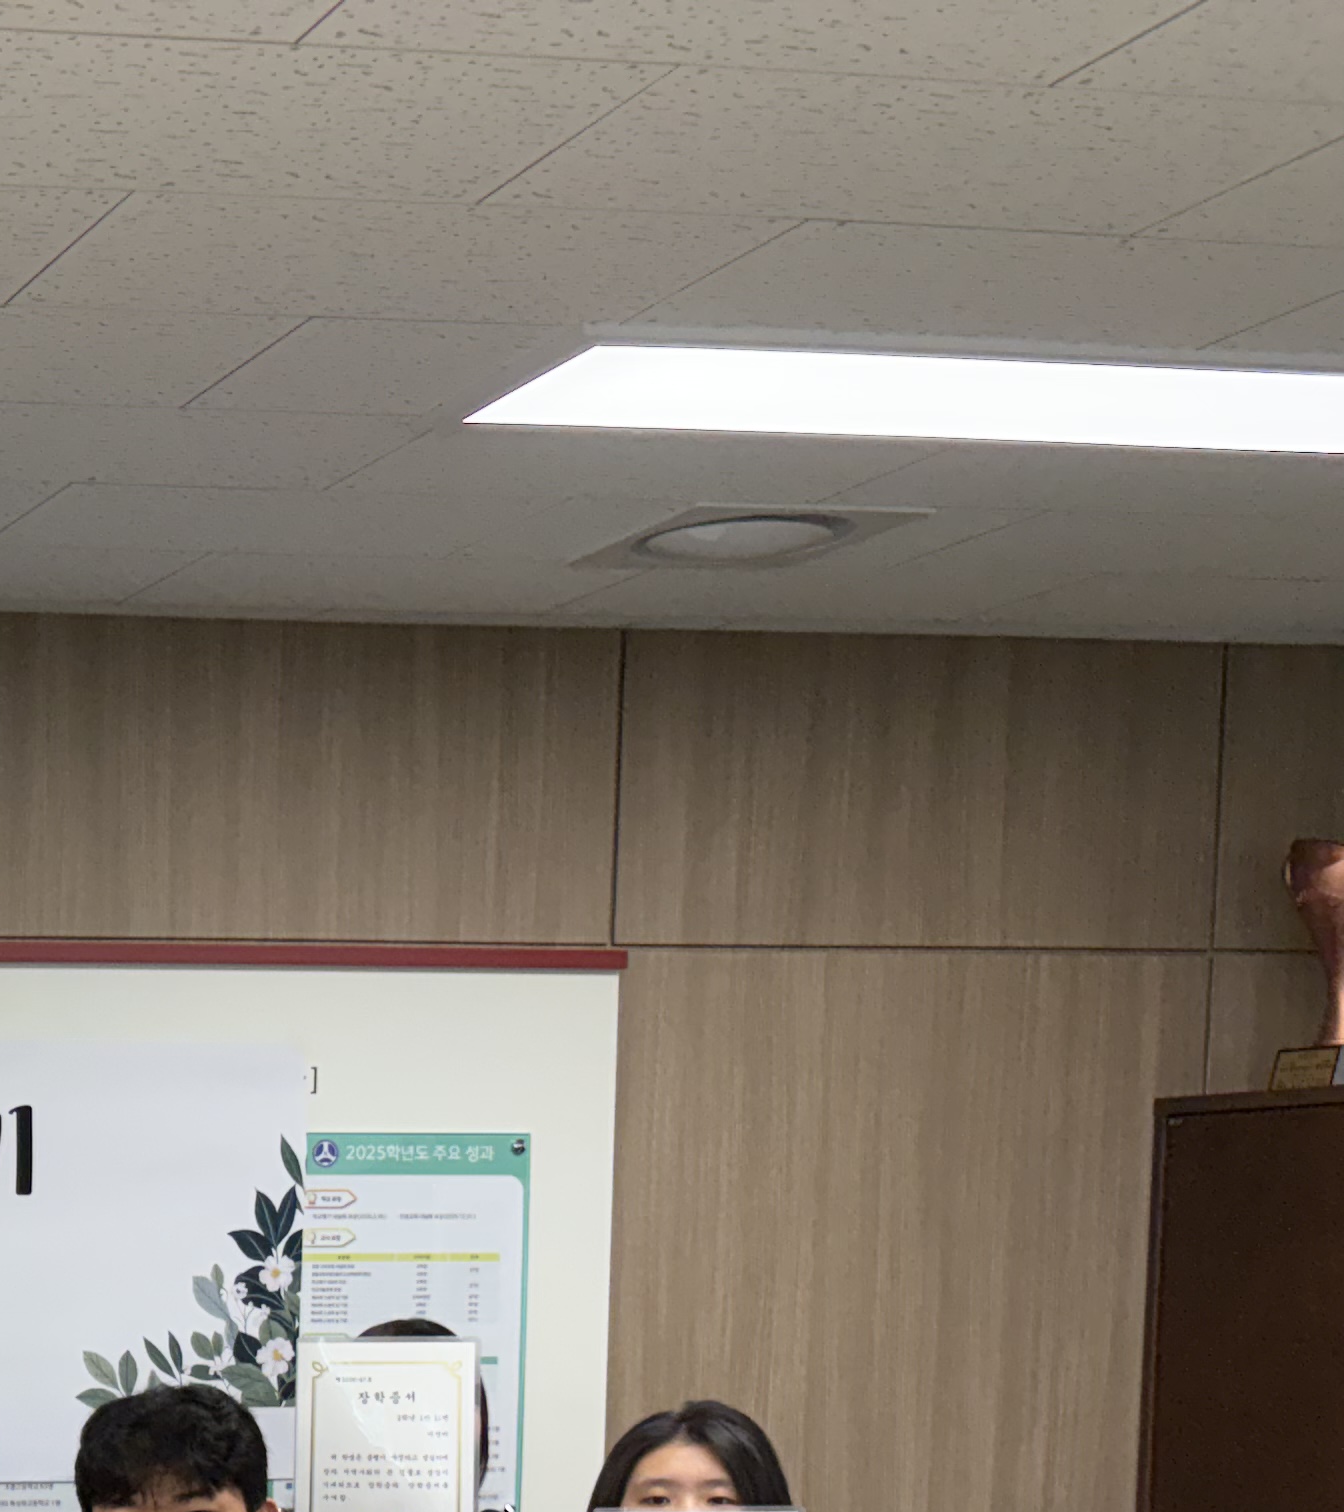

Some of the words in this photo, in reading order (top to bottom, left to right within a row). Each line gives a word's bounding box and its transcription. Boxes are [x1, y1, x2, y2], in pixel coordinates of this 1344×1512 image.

[346, 1145, 430, 1161] 2025학년도
[433, 1146, 461, 1161] 주요
[465, 1145, 495, 1162] 성과
